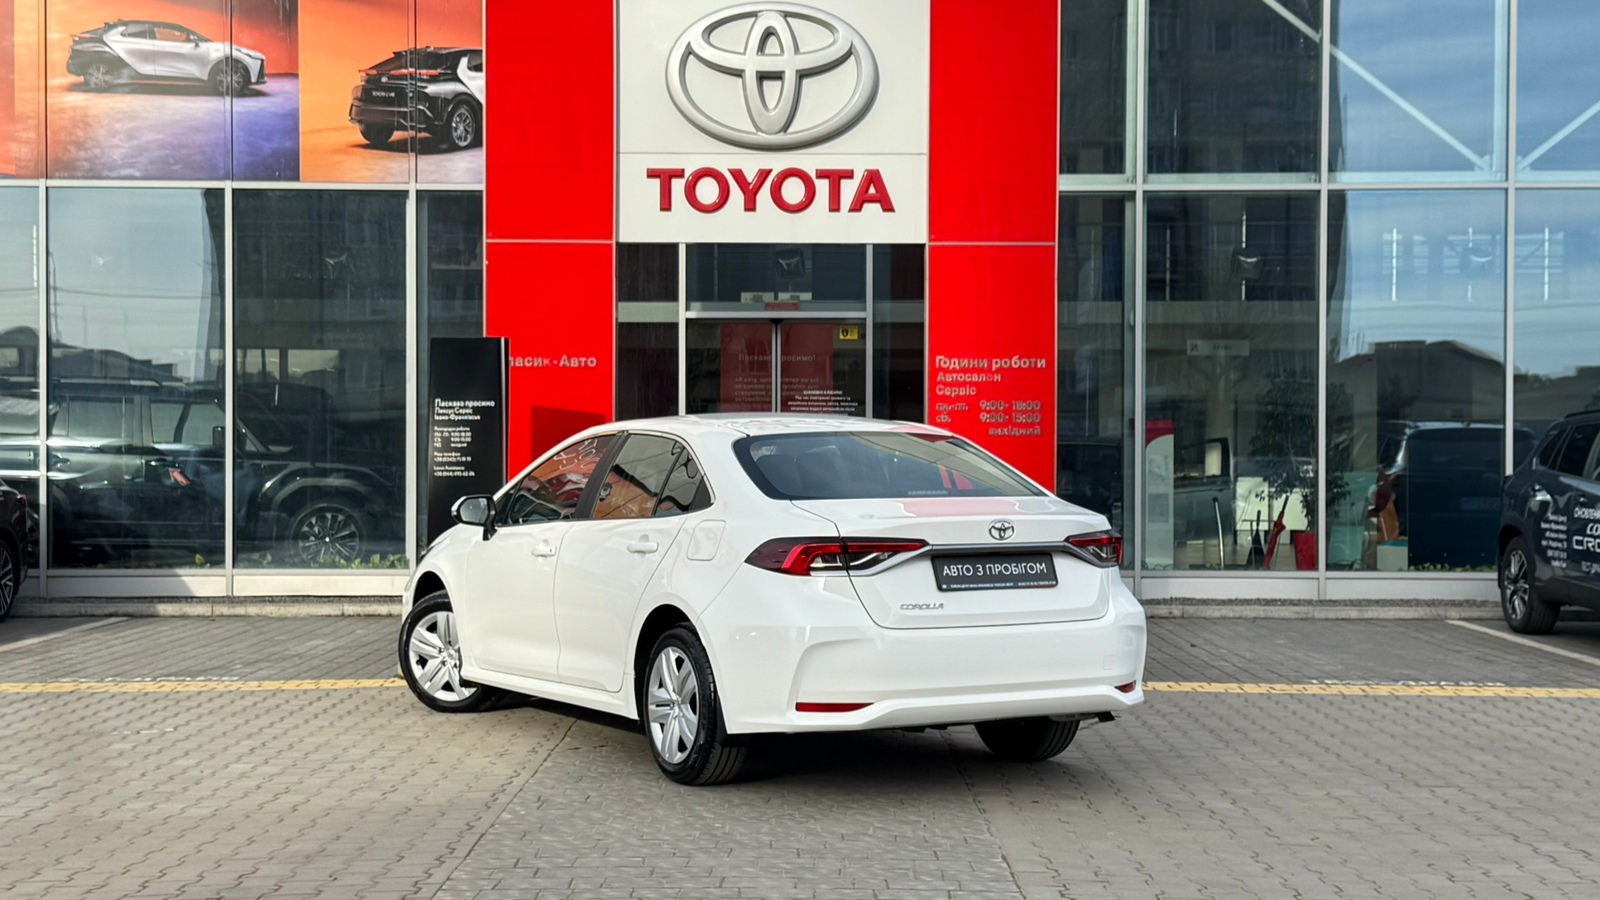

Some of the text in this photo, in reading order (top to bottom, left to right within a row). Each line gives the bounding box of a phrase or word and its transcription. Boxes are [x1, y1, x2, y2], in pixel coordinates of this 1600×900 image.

[646, 167, 896, 214] TOYOTA
[936, 355, 1047, 371] Години роботи
[937, 372, 1002, 382] Автосалон
[936, 385, 977, 398] Сервіс
[435, 398, 464, 407] Ласкаво
[943, 562, 1047, 576] АВТО З ПРОБІГОМ
